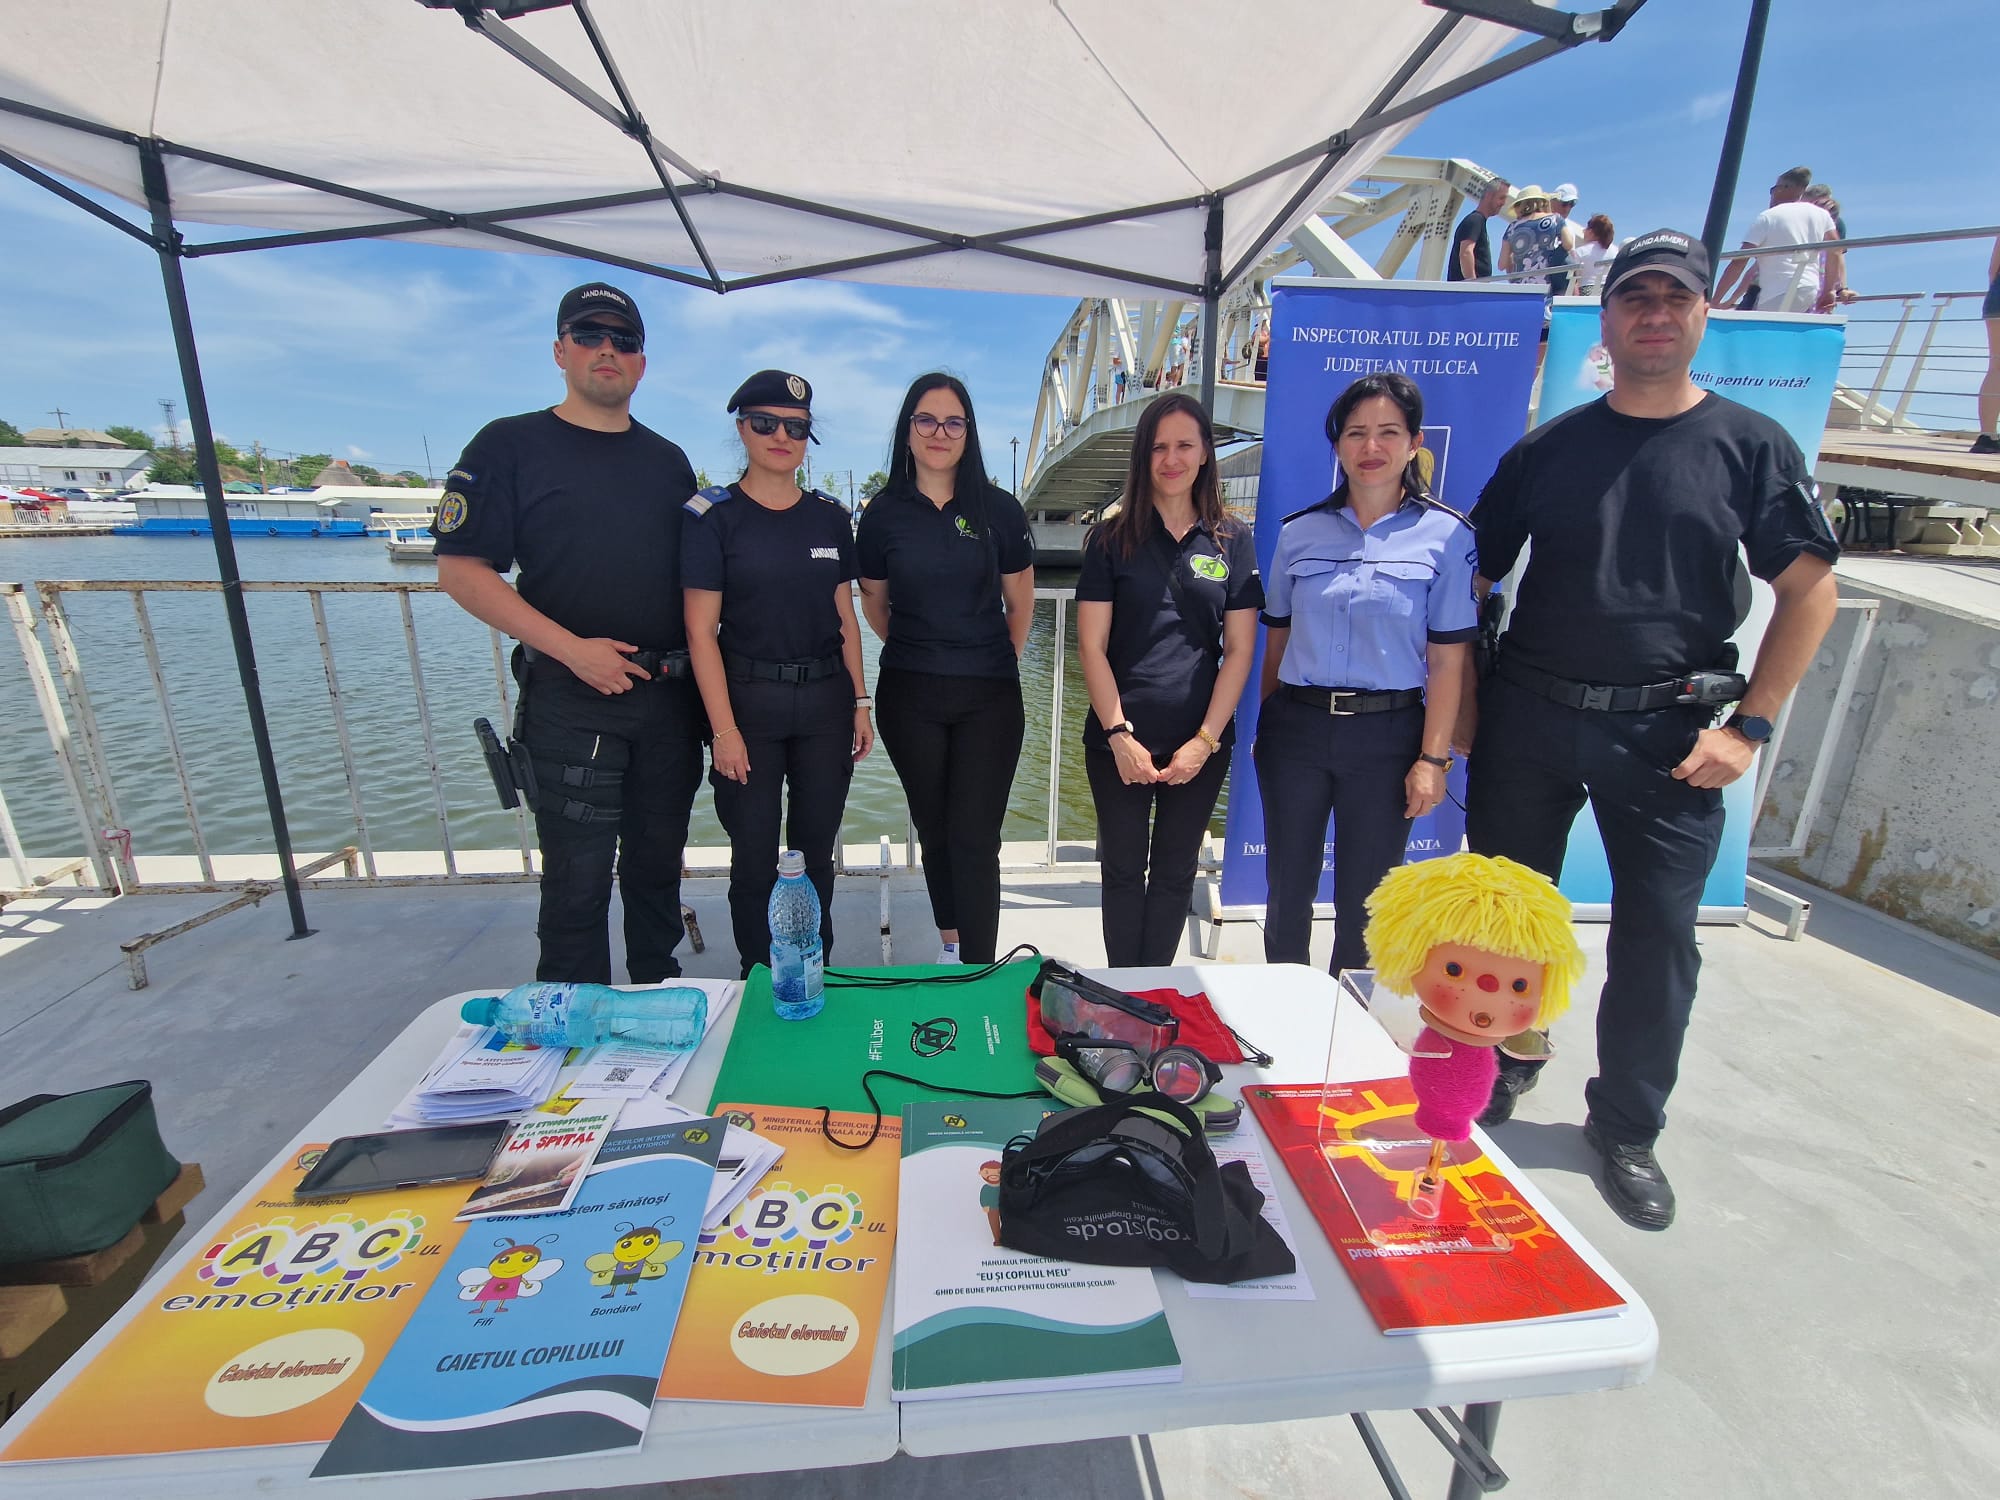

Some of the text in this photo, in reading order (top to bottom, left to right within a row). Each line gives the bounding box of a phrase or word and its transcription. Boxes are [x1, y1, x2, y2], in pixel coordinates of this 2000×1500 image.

[1630, 235, 1689, 251] JANDARMERIA
[581, 289, 627, 306] JANDARMERIA
[1292, 327, 1520, 350] INSPECTORATUL DE POLIȚIE
[1412, 359, 1479, 375] TULCEA
[1715, 376, 1763, 387] pentru
[868, 1019, 884, 1061] #FiiLiber
[762, 1116, 812, 1126] MINISTERUL
[764, 1124, 802, 1134] AGENȚIA
[508, 1132, 595, 1152] LA SPITAL
[608, 1193, 671, 1210] sănătoși
[1084, 1210, 1132, 1221] Drogenhilfe
[1131, 1213, 1146, 1221] der
[1066, 1217, 1191, 1241] rogisto.de
[692, 1250, 877, 1275] moțiilor
[981, 1258, 1019, 1267] MANUALUL
[995, 1271, 1005, 1283] ȘI
[1005, 1269, 1045, 1280] COPILUL
[161, 1282, 417, 1312] emoțiilor
[954, 1287, 965, 1295] DE
[965, 1286, 985, 1295] BUNE
[986, 1284, 1017, 1293] PRACTICI
[1017, 1283, 1045, 1292] PENTRU
[589, 1303, 643, 1317] Bondărel
[473, 1317, 495, 1328] Fifi
[738, 1321, 849, 1341] Caietul elevului
[436, 1339, 625, 1373] CAIETUL COPILULUI
[218, 1357, 351, 1383] Caietul elevului
